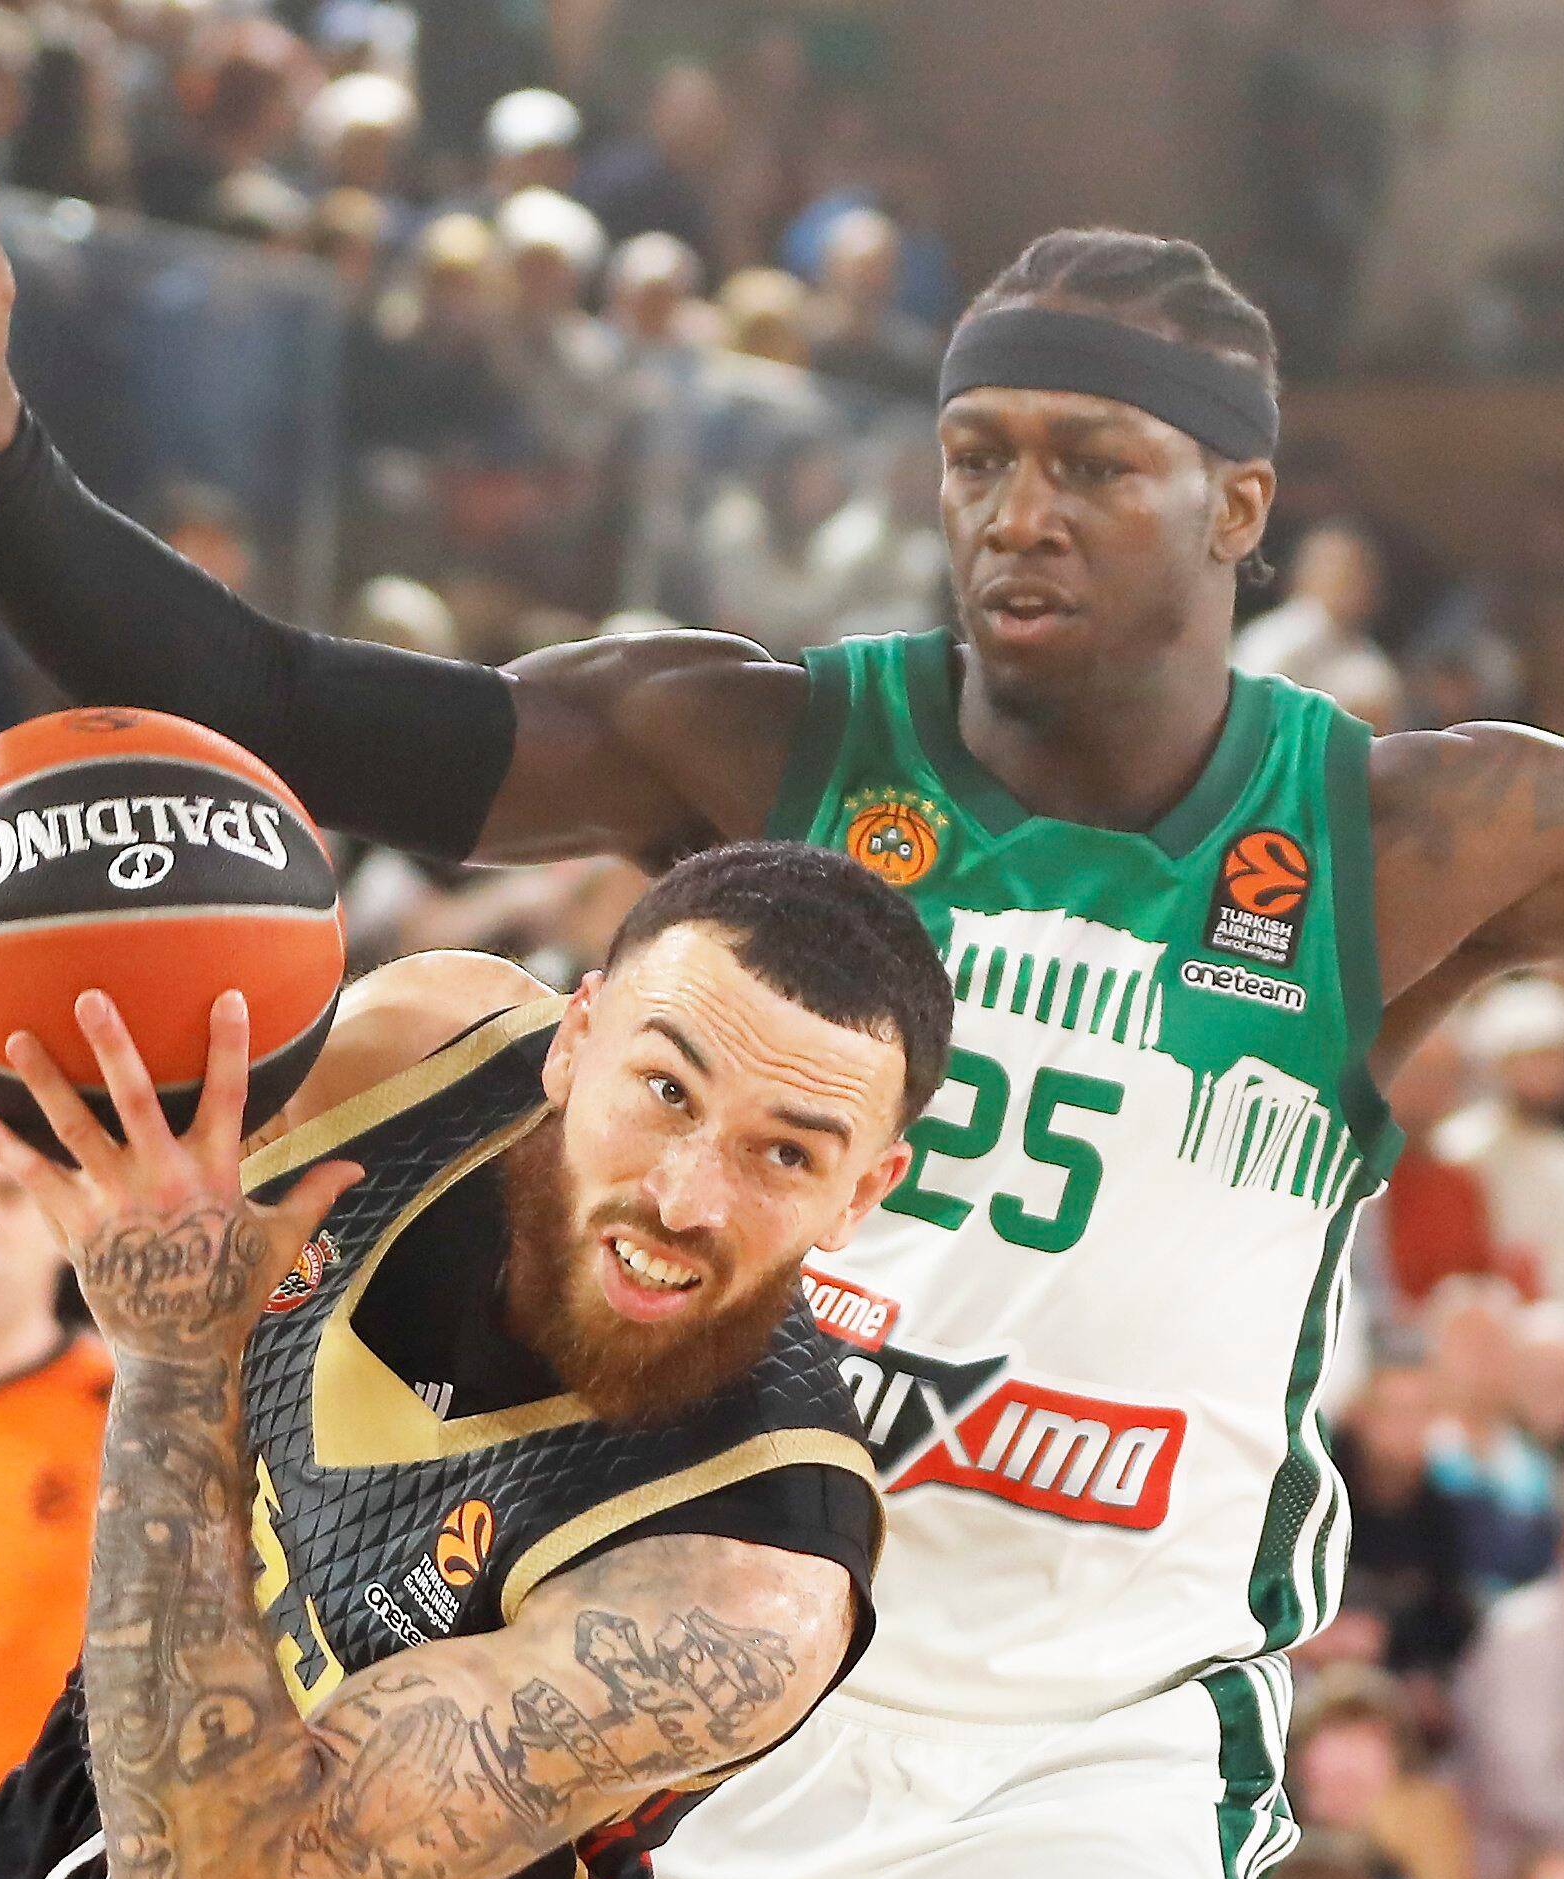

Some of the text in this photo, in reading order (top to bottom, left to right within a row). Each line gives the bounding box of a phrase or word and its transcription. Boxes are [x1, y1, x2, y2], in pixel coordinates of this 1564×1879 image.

[1215, 920, 1290, 950] AIRLINES
[1220, 906, 1294, 938] TURKISH
[1185, 964, 1302, 1007] oneteam
[881, 1046, 1125, 1253] 25
[403, 1574, 450, 1634] EuroLeague
[410, 1565, 454, 1625] AIRLINES
[420, 1552, 460, 1614] TURKISH
[368, 1587, 428, 1646] onete
